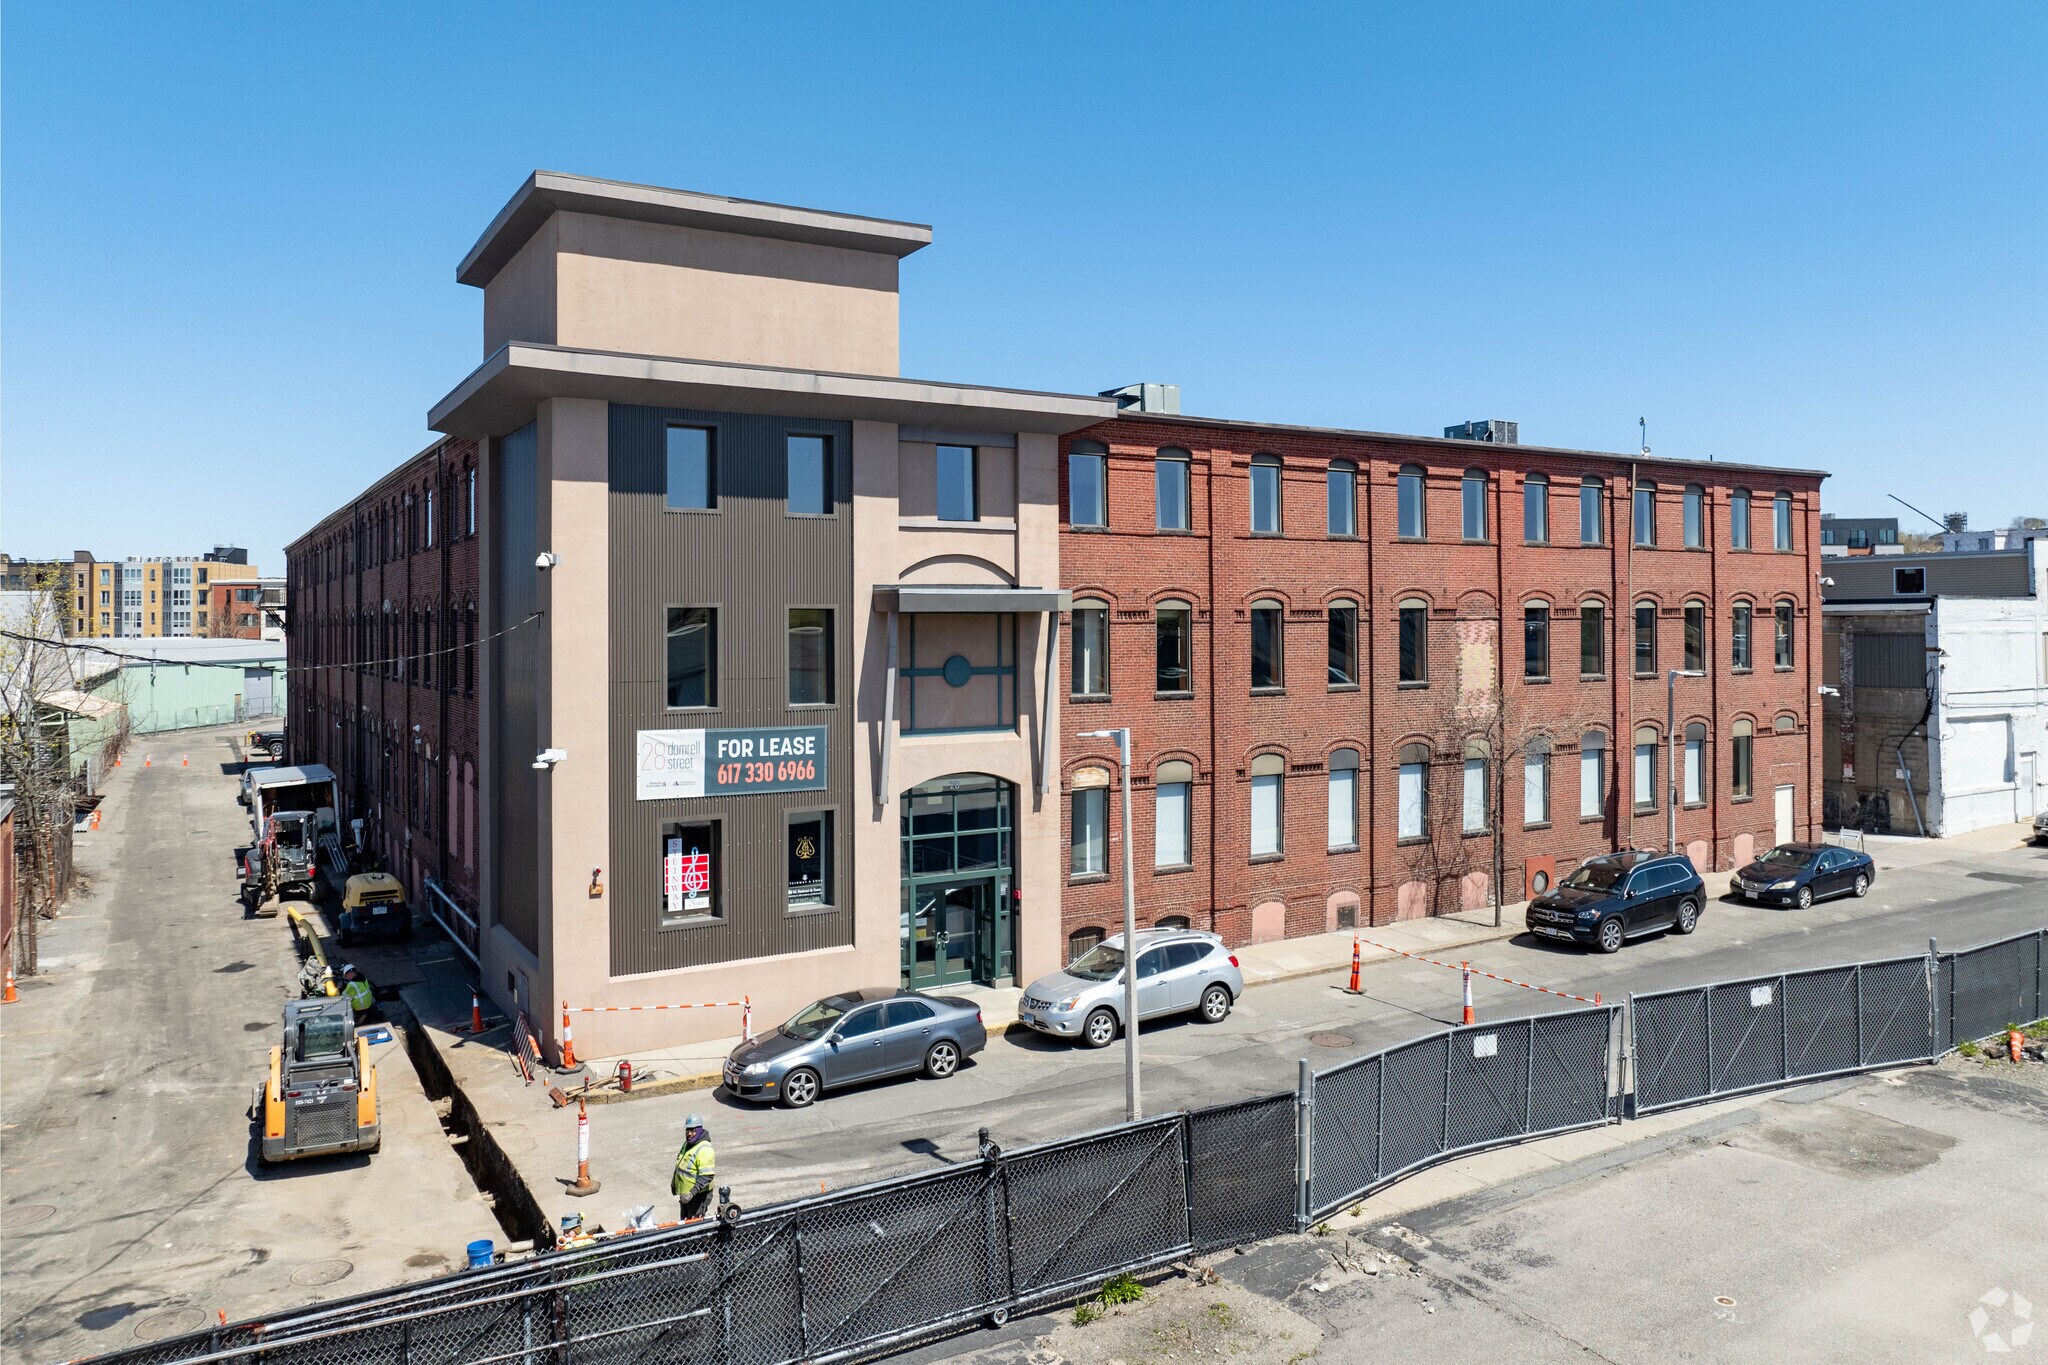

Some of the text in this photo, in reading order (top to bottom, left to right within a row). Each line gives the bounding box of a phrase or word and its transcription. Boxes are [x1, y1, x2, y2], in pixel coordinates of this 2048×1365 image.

[641, 741, 701, 771] 28 damrell
[718, 736, 816, 759] FOR LEASE
[667, 757, 694, 770] street
[717, 760, 816, 785] 617 330 6966
